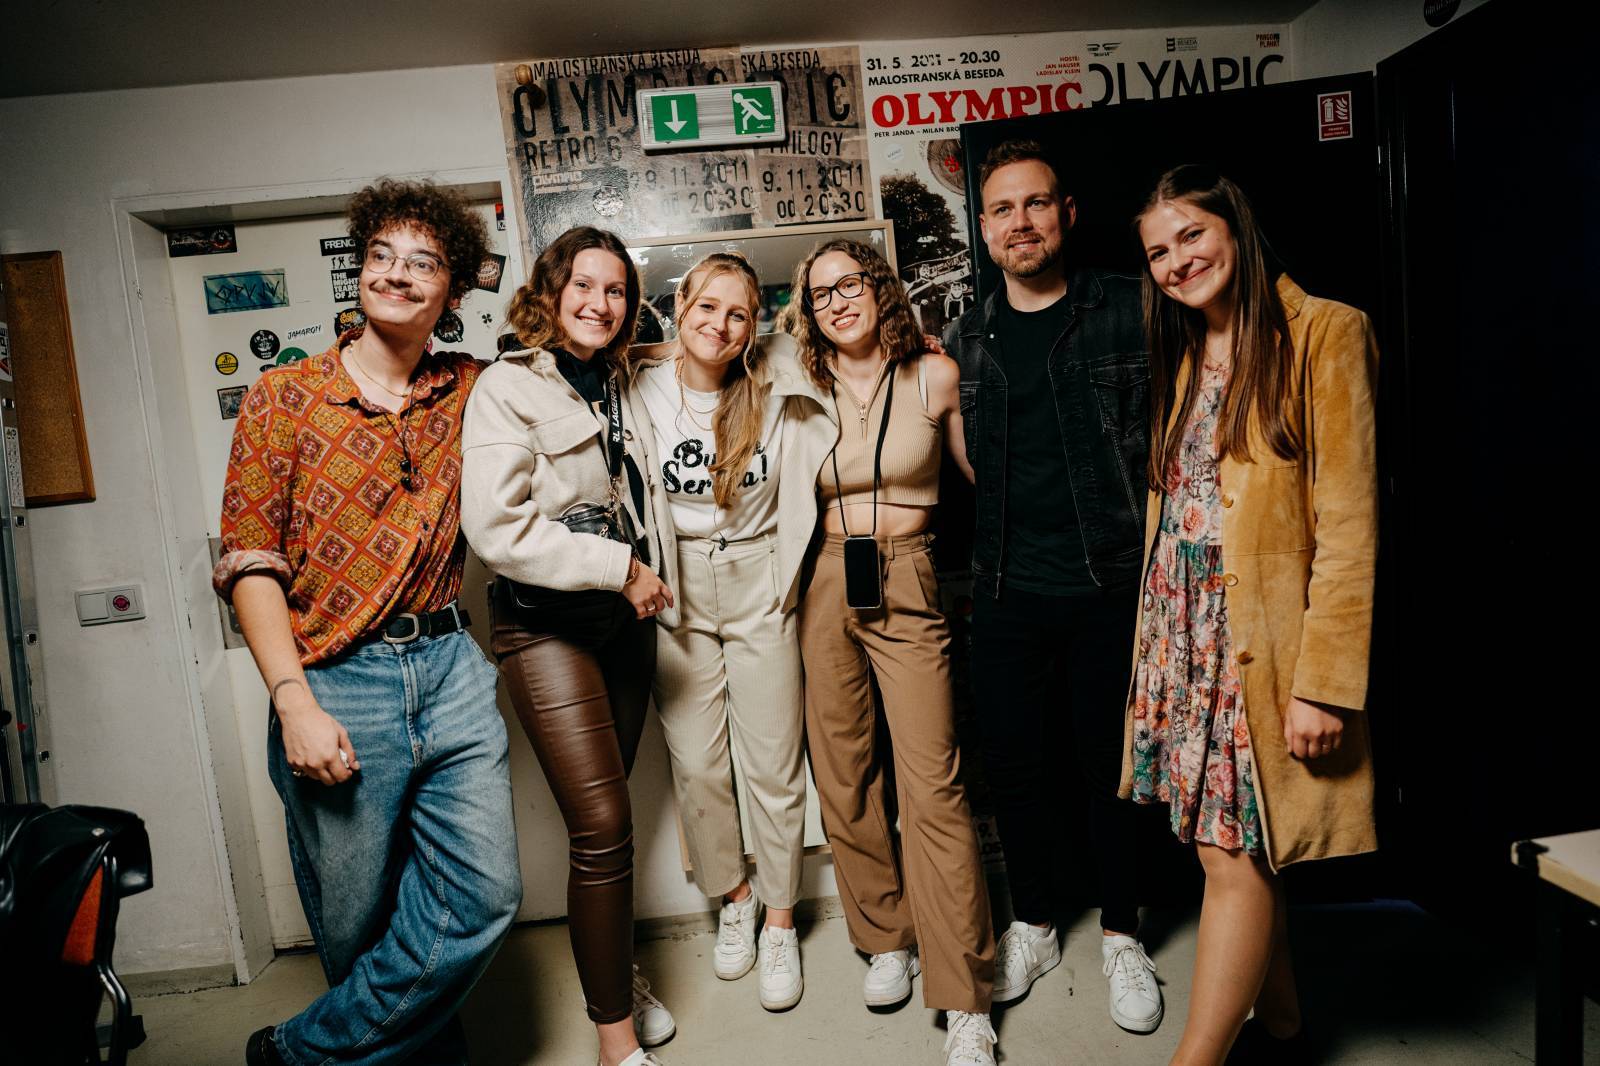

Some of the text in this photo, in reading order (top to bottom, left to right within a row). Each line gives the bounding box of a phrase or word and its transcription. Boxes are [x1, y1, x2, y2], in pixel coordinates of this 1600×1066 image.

[866, 58, 887, 71] 31.
[959, 51, 1000, 65] 20.30
[868, 68, 1005, 86] MALOSTRANSKÁ BESEDA
[872, 83, 1084, 128] OLYMPIC
[874, 130, 890, 138] PETR
[892, 129, 915, 137] JANDA
[922, 127, 944, 135] MILAN
[523, 136, 597, 171] RETRO
[324, 239, 356, 250] FRENC
[332, 272, 347, 280] THE
[333, 278, 360, 287] MIGHT
[334, 284, 359, 292] TEARS
[608, 376, 620, 428] LAGERFE
